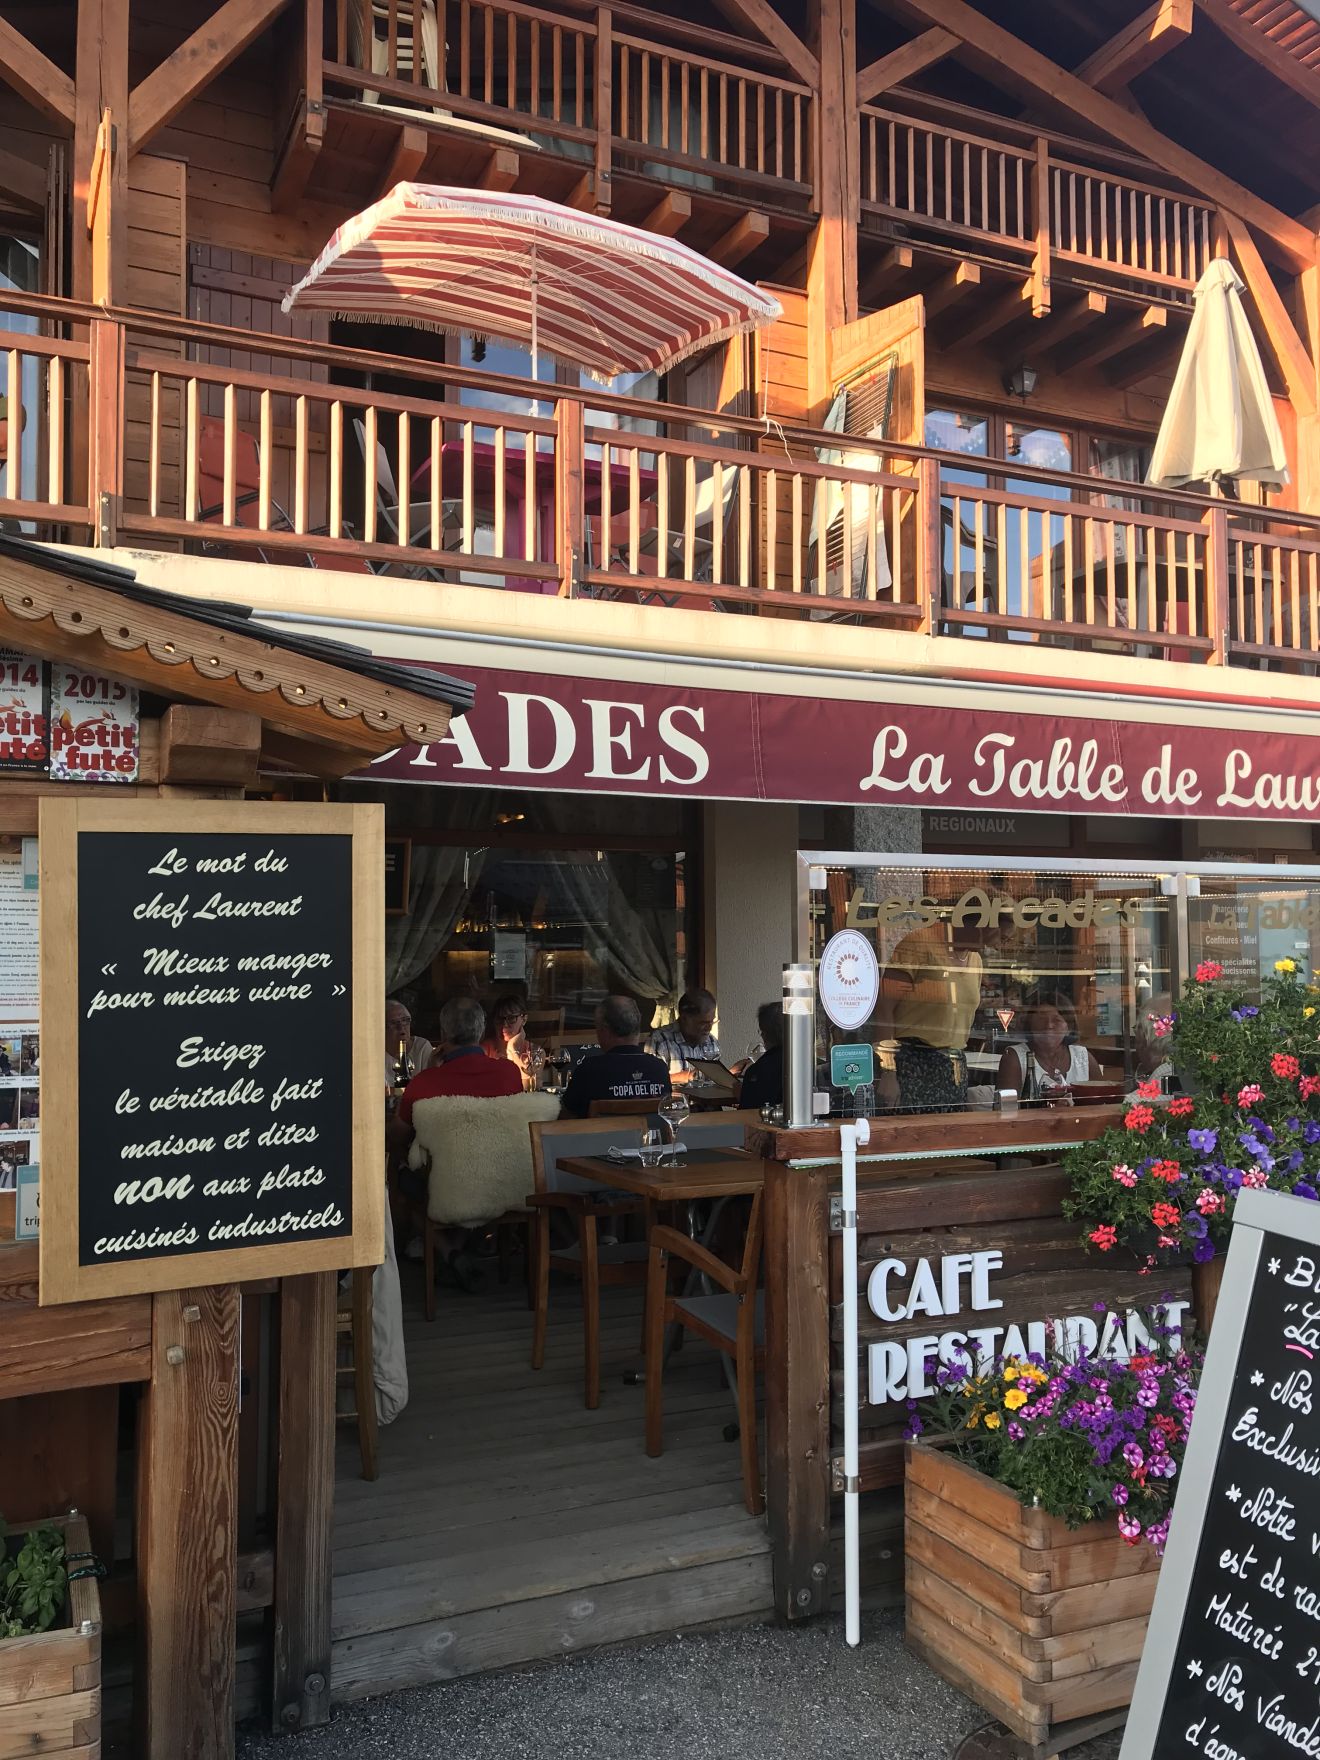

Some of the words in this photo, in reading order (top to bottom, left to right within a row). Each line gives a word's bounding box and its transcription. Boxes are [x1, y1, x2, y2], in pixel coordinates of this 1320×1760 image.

[64, 673, 127, 700] 2015
[53, 723, 136, 751] petit
[370, 691, 710, 785] ADES
[65, 745, 136, 773] futé
[859, 725, 952, 795] La
[968, 732, 1129, 802] Table
[1141, 744, 1203, 805] de
[929, 816, 1016, 833] REGIONAUX
[148, 847, 188, 876] Le
[196, 852, 247, 873] mot
[254, 849, 289, 873] du
[133, 892, 189, 928] chef
[192, 892, 302, 920] Laurent
[846, 887, 938, 928] Les
[951, 886, 1151, 929] Arcades
[1205, 935, 1239, 945] Confitures
[1244, 935, 1257, 944] Miel
[143, 948, 230, 976] Mieux
[237, 952, 333, 979] manger
[86, 990, 155, 1019] pour
[163, 984, 241, 1007] mieux
[248, 981, 313, 1002] vivre
[176, 1036, 266, 1071] Exigez
[114, 1088, 140, 1114] le
[149, 1077, 264, 1112] véritable
[270, 1077, 324, 1112] fait
[635, 1083, 649, 1095] DEL
[120, 1134, 216, 1159] maison
[223, 1127, 250, 1150] et
[257, 1122, 319, 1147] dites
[113, 1174, 195, 1205] non
[202, 1176, 252, 1196] aux
[256, 1164, 326, 1200] plats
[93, 1222, 200, 1255] cuisinés
[207, 1203, 344, 1241] industriels
[867, 1250, 1004, 1322] CAFE
[868, 1301, 1191, 1405] RESTAURANT
[1270, 1369, 1313, 1415] Nos
[1240, 1487, 1296, 1541] Notre
[1219, 1544, 1258, 1580] est
[1260, 1556, 1285, 1599] de
[1205, 1593, 1284, 1660] Maturée
[1206, 1662, 1245, 1712] Nos
